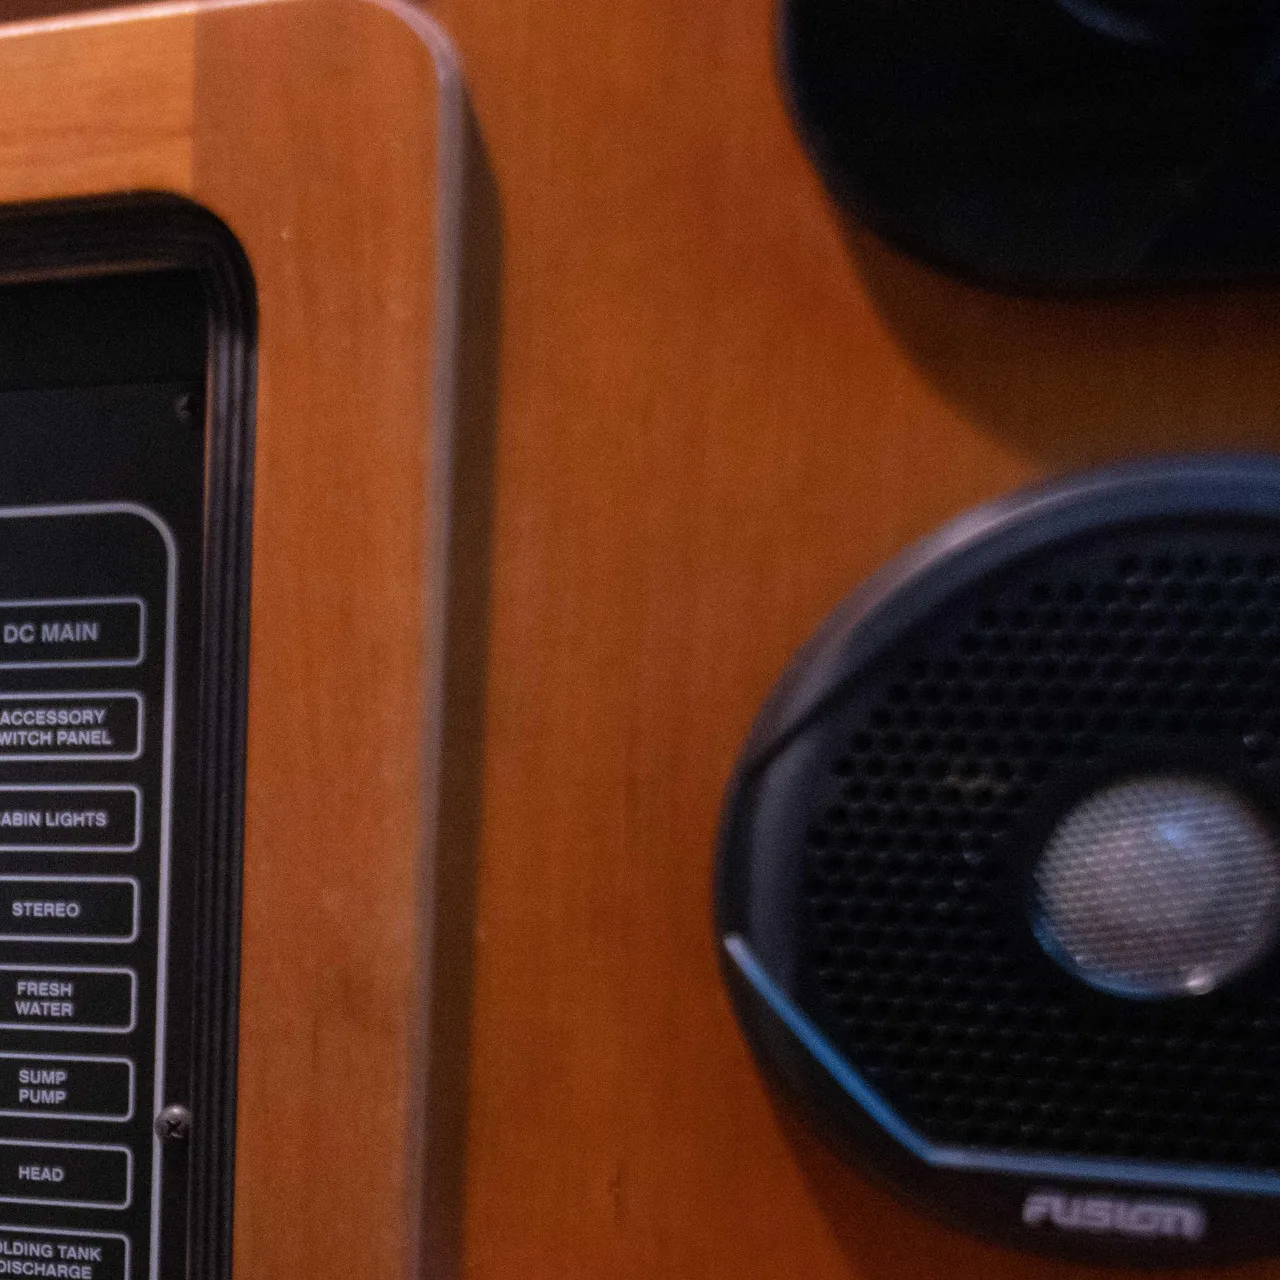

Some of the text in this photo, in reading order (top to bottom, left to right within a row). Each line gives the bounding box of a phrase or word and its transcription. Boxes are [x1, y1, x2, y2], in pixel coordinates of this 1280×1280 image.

[3, 622, 100, 643] DC MAIN
[0, 709, 106, 725] ACCESSORY
[56, 730, 112, 745] PANEL
[45, 812, 107, 827] LIGHTS
[12, 902, 80, 917] STEREO
[17, 981, 73, 996] FRESH
[15, 1001, 74, 1017] WATER
[19, 1069, 67, 1085] SUMP
[18, 1089, 67, 1104] PUMP
[18, 1165, 64, 1182] HEAD
[1023, 1194, 1207, 1240] FUSION
[57, 1245, 102, 1262] TANK
